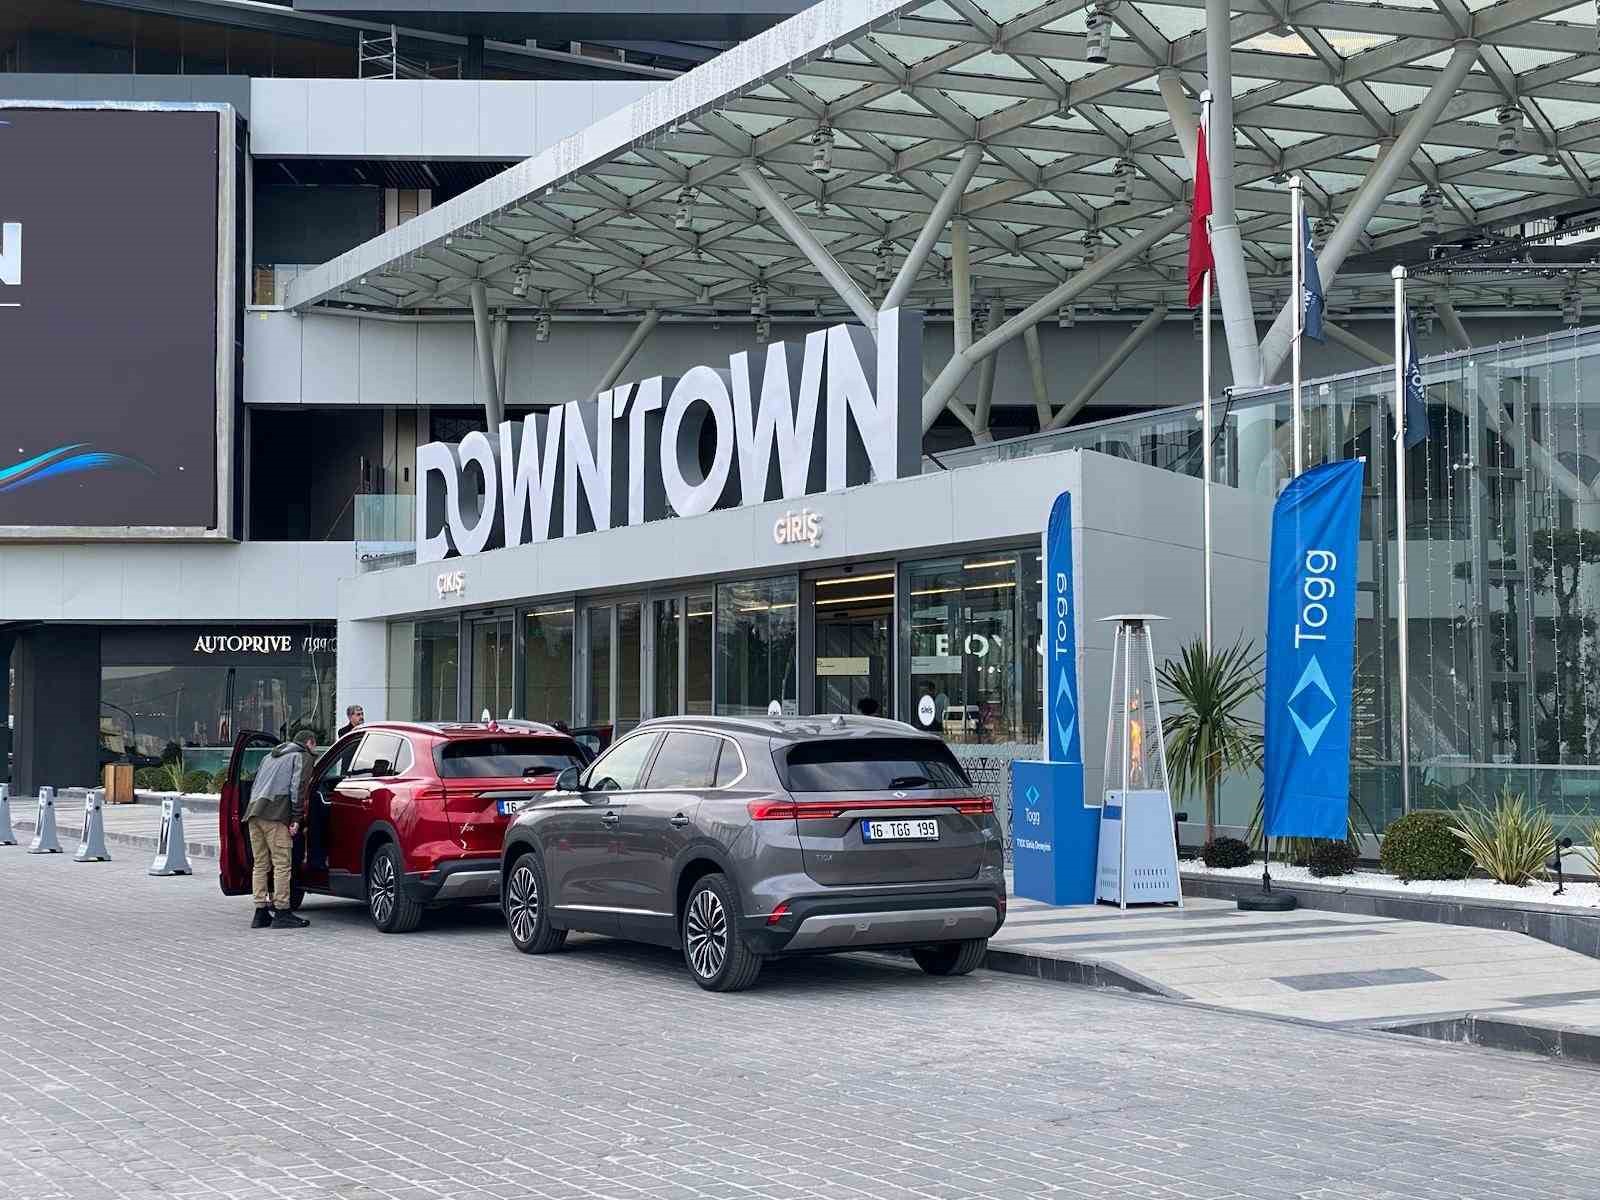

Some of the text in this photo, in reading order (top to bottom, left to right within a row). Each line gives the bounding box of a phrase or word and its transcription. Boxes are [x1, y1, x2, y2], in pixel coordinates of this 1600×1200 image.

[416, 307, 900, 564] DOWNTOWN
[774, 509, 822, 547] GİRİŞ
[1055, 572, 1068, 661] Togg
[1295, 550, 1337, 649] Togg
[194, 635, 292, 653] AUTOPRIVE
[871, 822, 936, 838] 16 TGG 199
[1025, 807, 1040, 826] Togg
